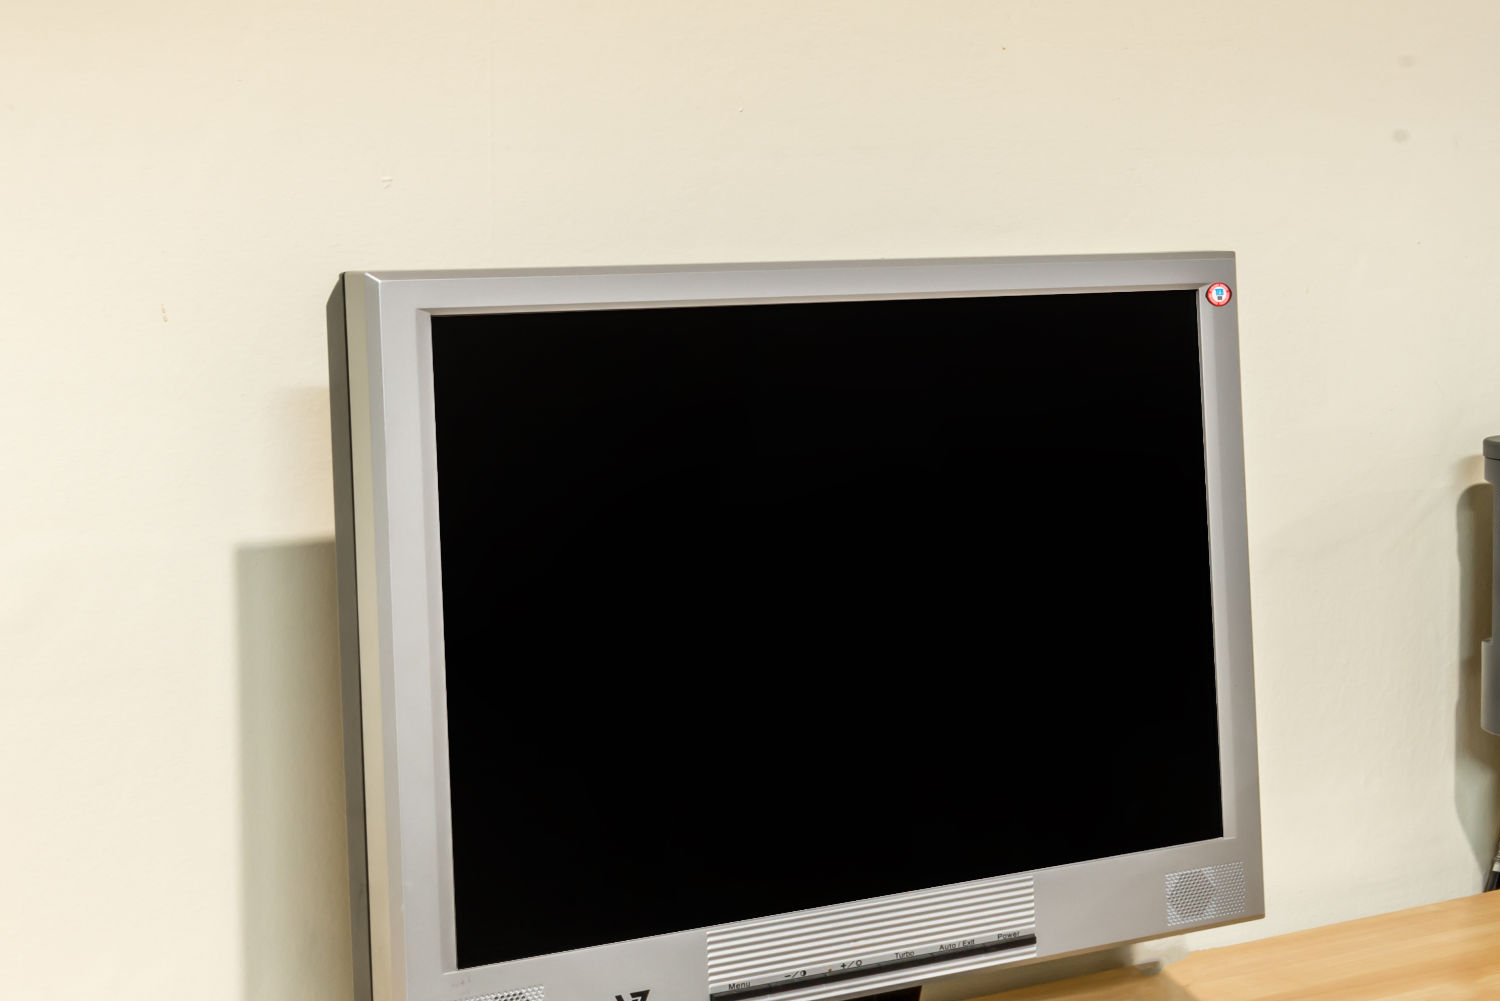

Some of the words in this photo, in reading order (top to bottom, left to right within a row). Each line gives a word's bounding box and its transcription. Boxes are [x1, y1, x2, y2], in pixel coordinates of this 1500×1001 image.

[997, 931, 1020, 940] Power
[938, 943, 956, 952] Auto
[962, 938, 976, 947] Exit
[893, 950, 915, 960] Turbo
[728, 981, 751, 990] Menu
